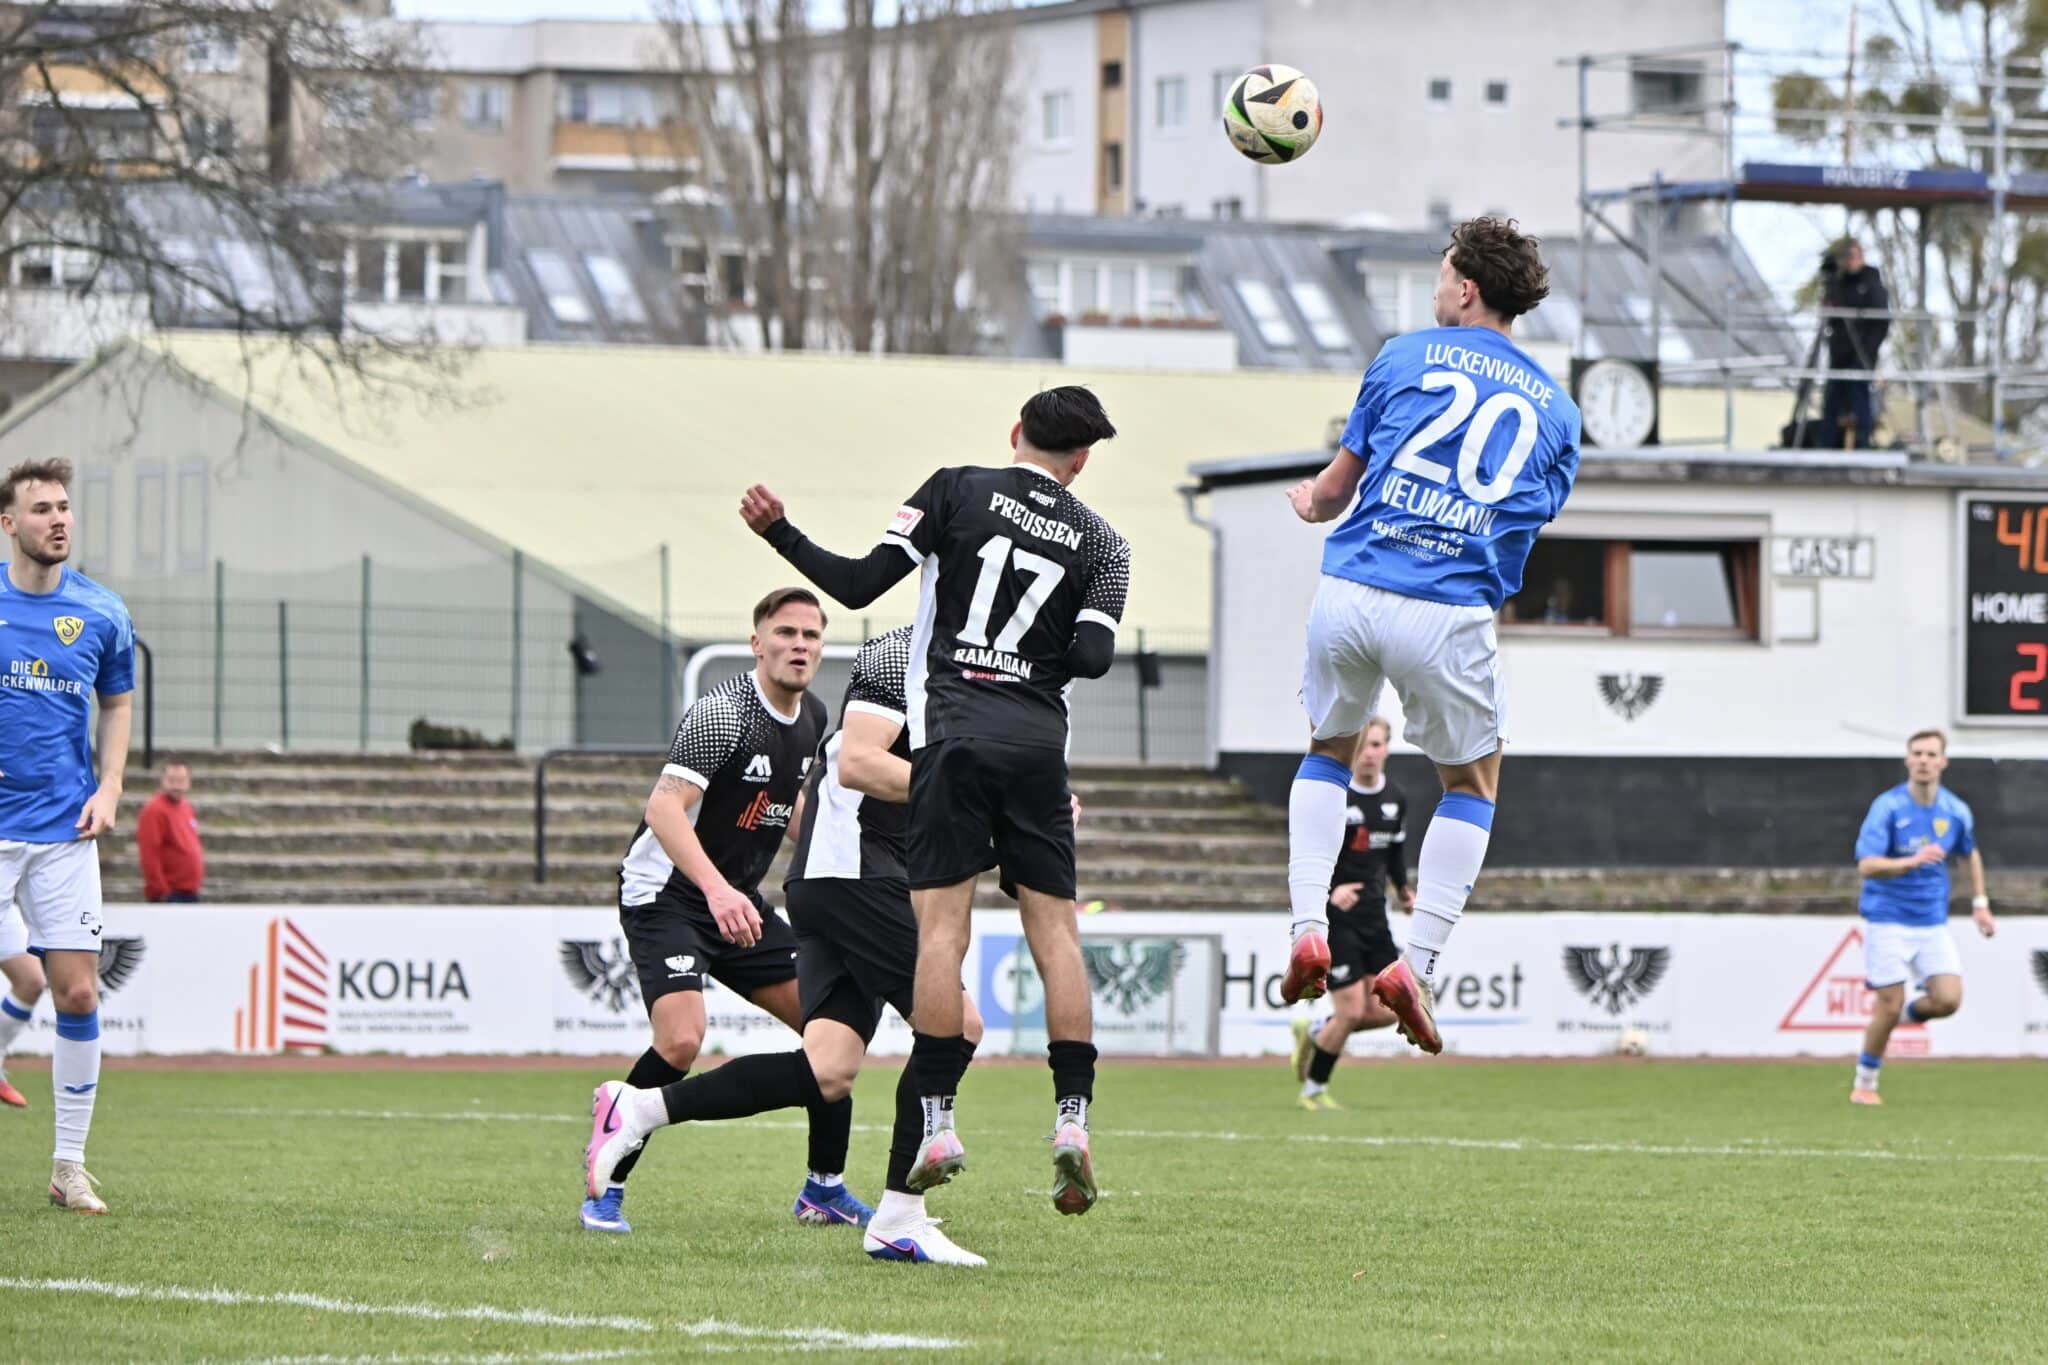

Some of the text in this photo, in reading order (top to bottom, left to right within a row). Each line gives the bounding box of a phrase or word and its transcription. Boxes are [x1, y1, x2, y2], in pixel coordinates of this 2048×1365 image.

[1425, 344, 1554, 408] LUCKENWALDE
[1392, 371, 1538, 504] 20
[988, 492, 1083, 551] PREUSSEN
[1371, 519, 1463, 558] Mäkischer Hof
[1789, 539, 1858, 576] GAST
[956, 534, 1066, 653] 17
[1971, 593, 2047, 624] HOME
[11, 660, 31, 674] DIE
[953, 648, 1033, 680] RAMADAN
[2009, 643, 2048, 710] 2
[0, 674, 81, 695] CKENWALDER
[338, 960, 470, 1000] KOHA
